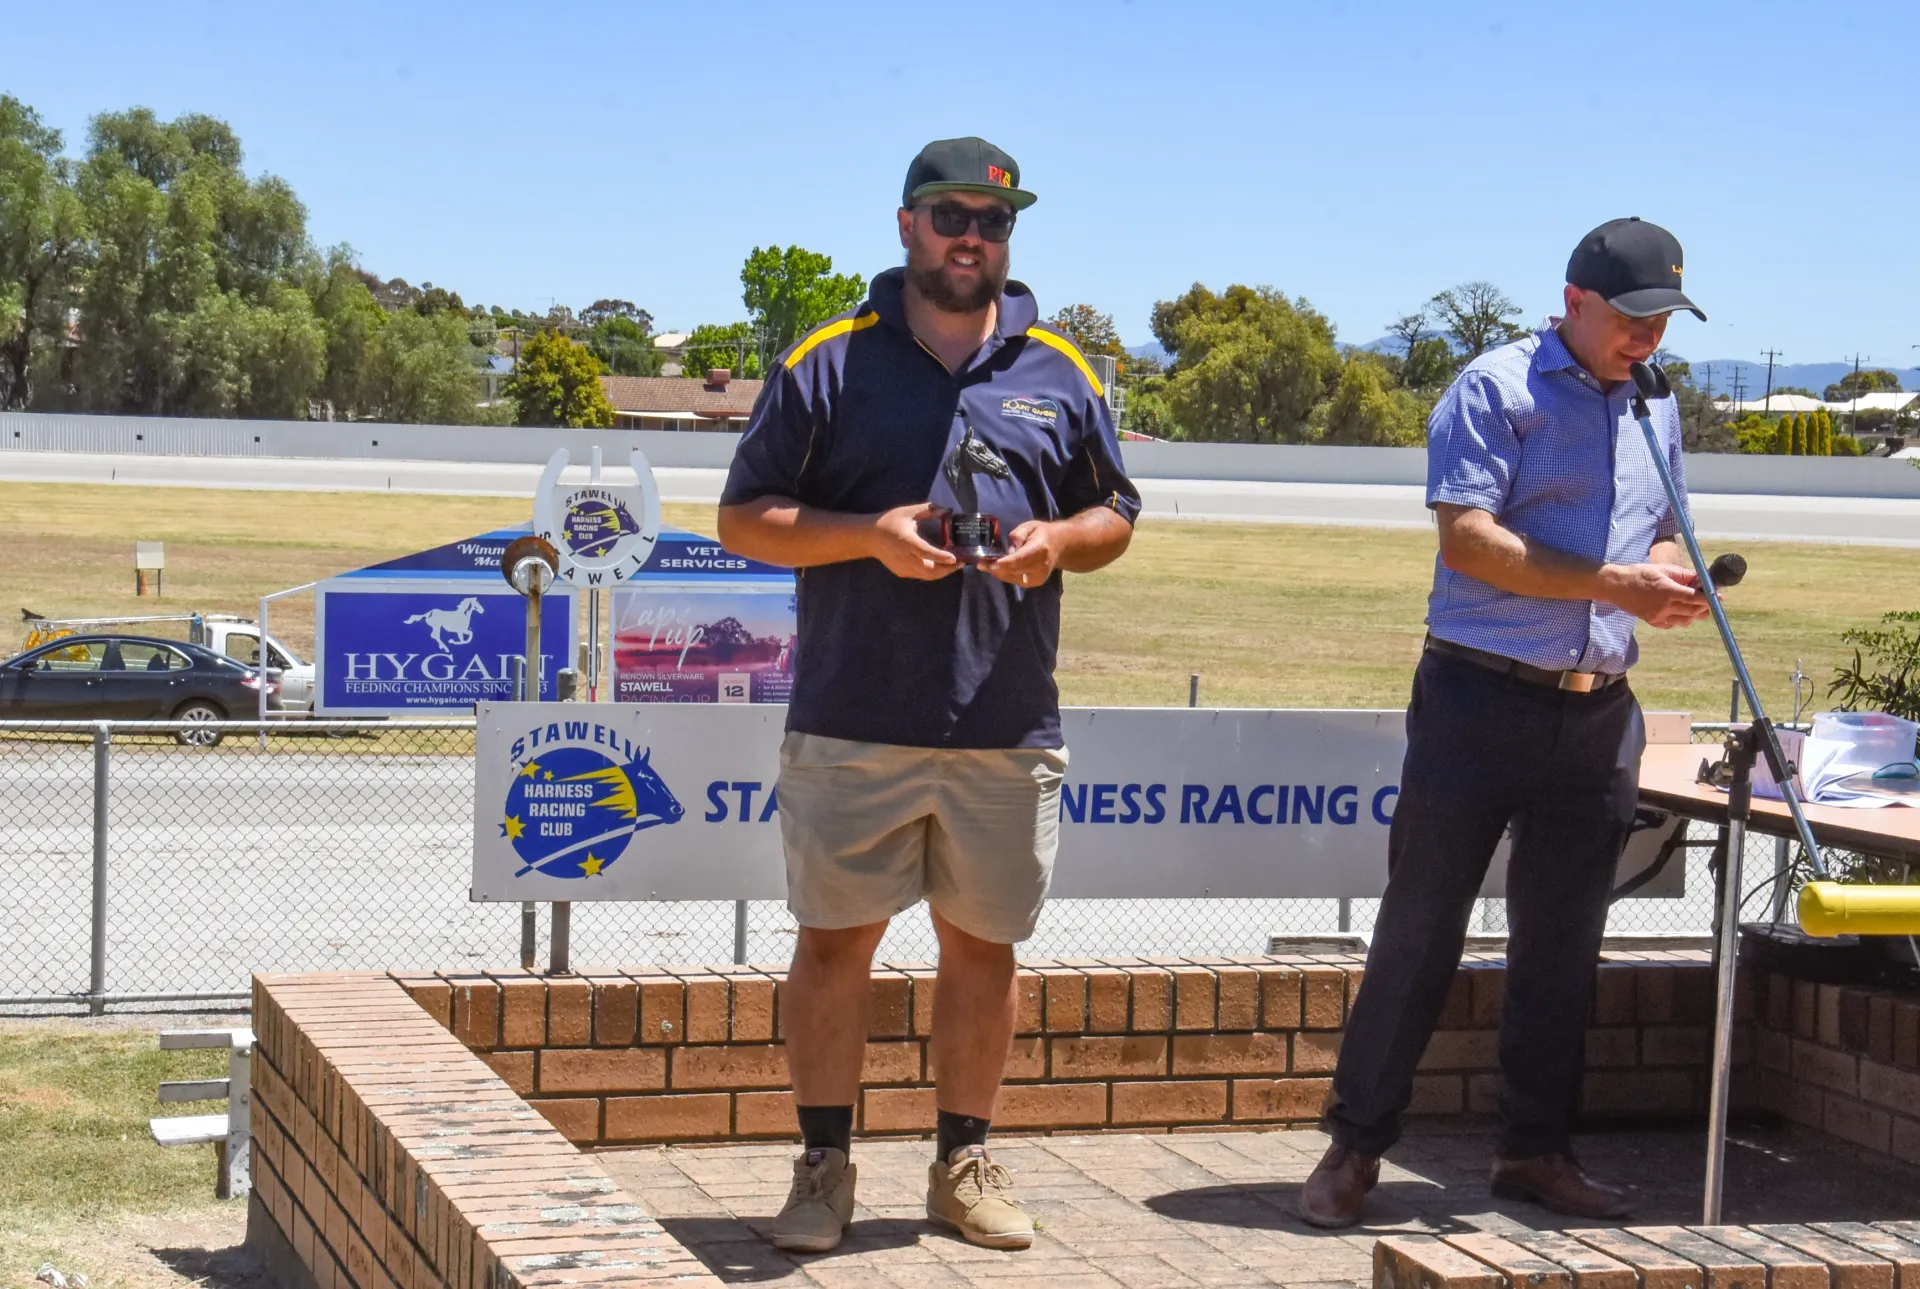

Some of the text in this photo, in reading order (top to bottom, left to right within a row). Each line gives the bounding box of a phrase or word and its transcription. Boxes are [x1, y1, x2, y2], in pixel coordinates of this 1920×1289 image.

[565, 489, 619, 507] STAWELL
[573, 524, 599, 532] RACING
[578, 532, 593, 540] CLUB
[457, 544, 505, 555] Wimm
[686, 547, 722, 556] VET
[539, 531, 654, 585] SAWELL
[660, 558, 747, 569] SERVICES
[344, 653, 549, 681] HYGAIN
[346, 682, 512, 693] FEEDING CHAMPIONS SINC
[620, 682, 673, 692] STAWELL
[724, 685, 744, 697] 12
[511, 721, 634, 764] STAWELL
[524, 784, 593, 798] HARNESS
[529, 803, 585, 817] RACING
[1059, 783, 1166, 824] NESS
[1180, 784, 1358, 825] RACING
[540, 822, 572, 837] CLUB
